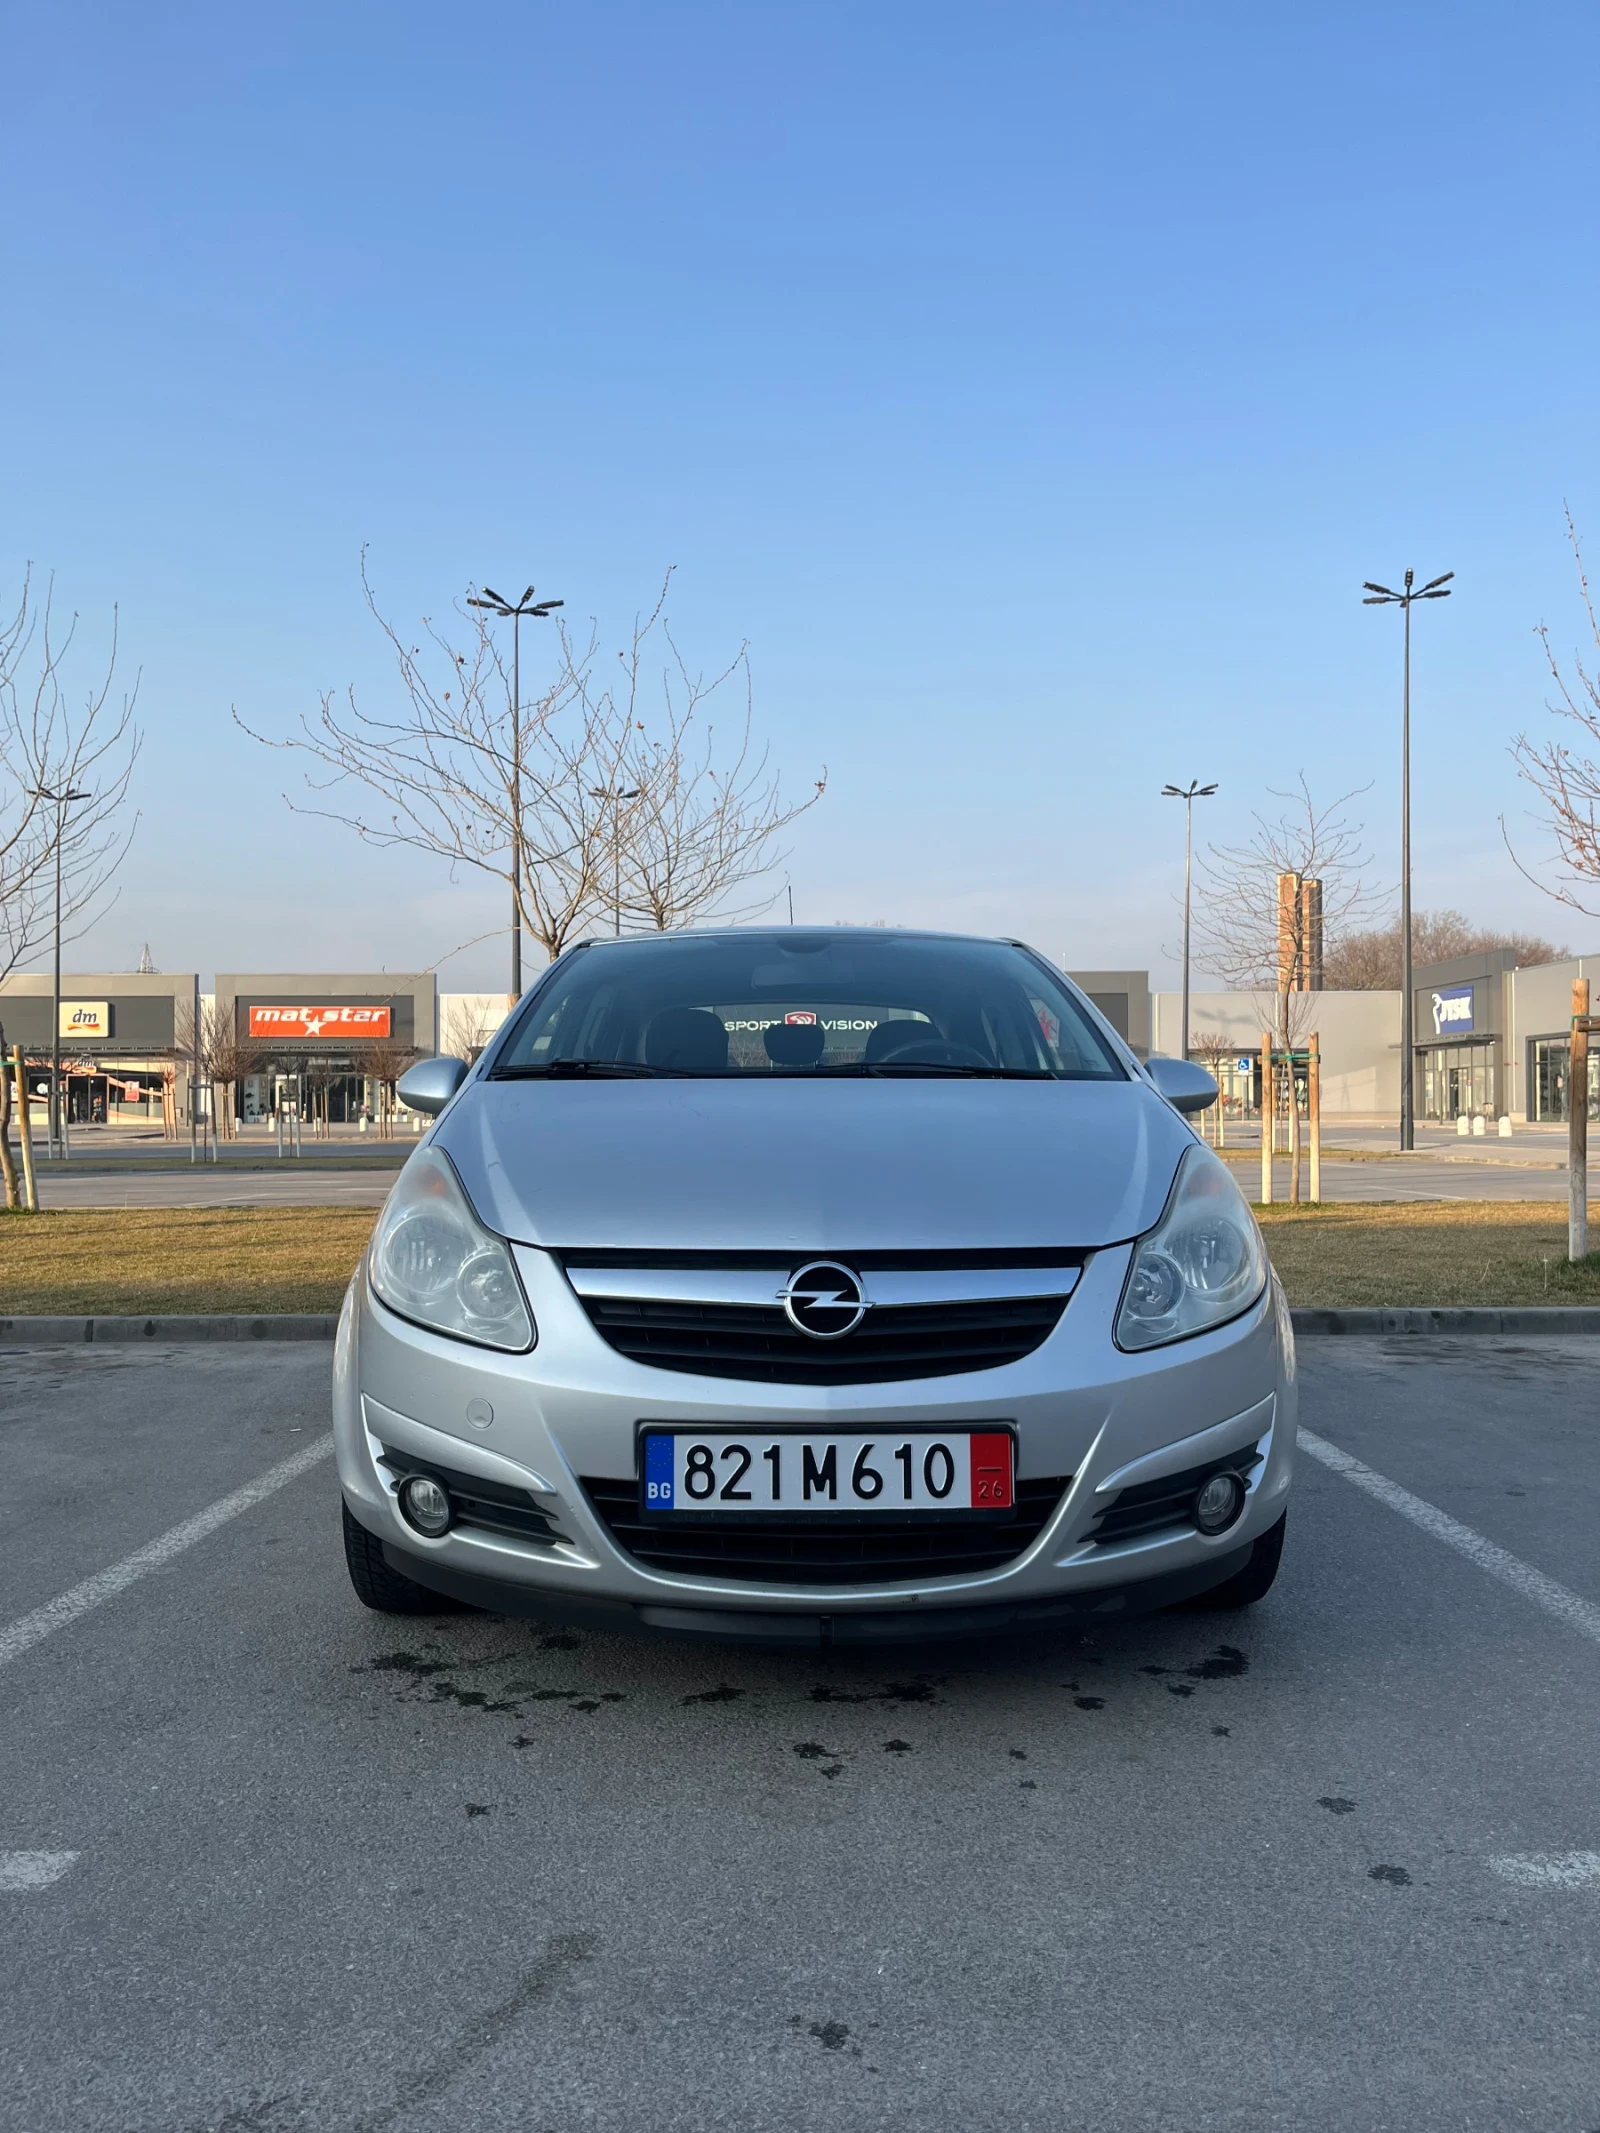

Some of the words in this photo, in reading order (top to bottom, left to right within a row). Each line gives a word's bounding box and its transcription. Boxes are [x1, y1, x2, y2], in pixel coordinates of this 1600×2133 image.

[72, 1009, 97, 1023] dm
[255, 1008, 312, 1022] mat
[321, 1008, 386, 1022] star
[820, 1020, 878, 1031] VISION
[648, 1482, 671, 1499] BG
[978, 1480, 1004, 1499] 26
